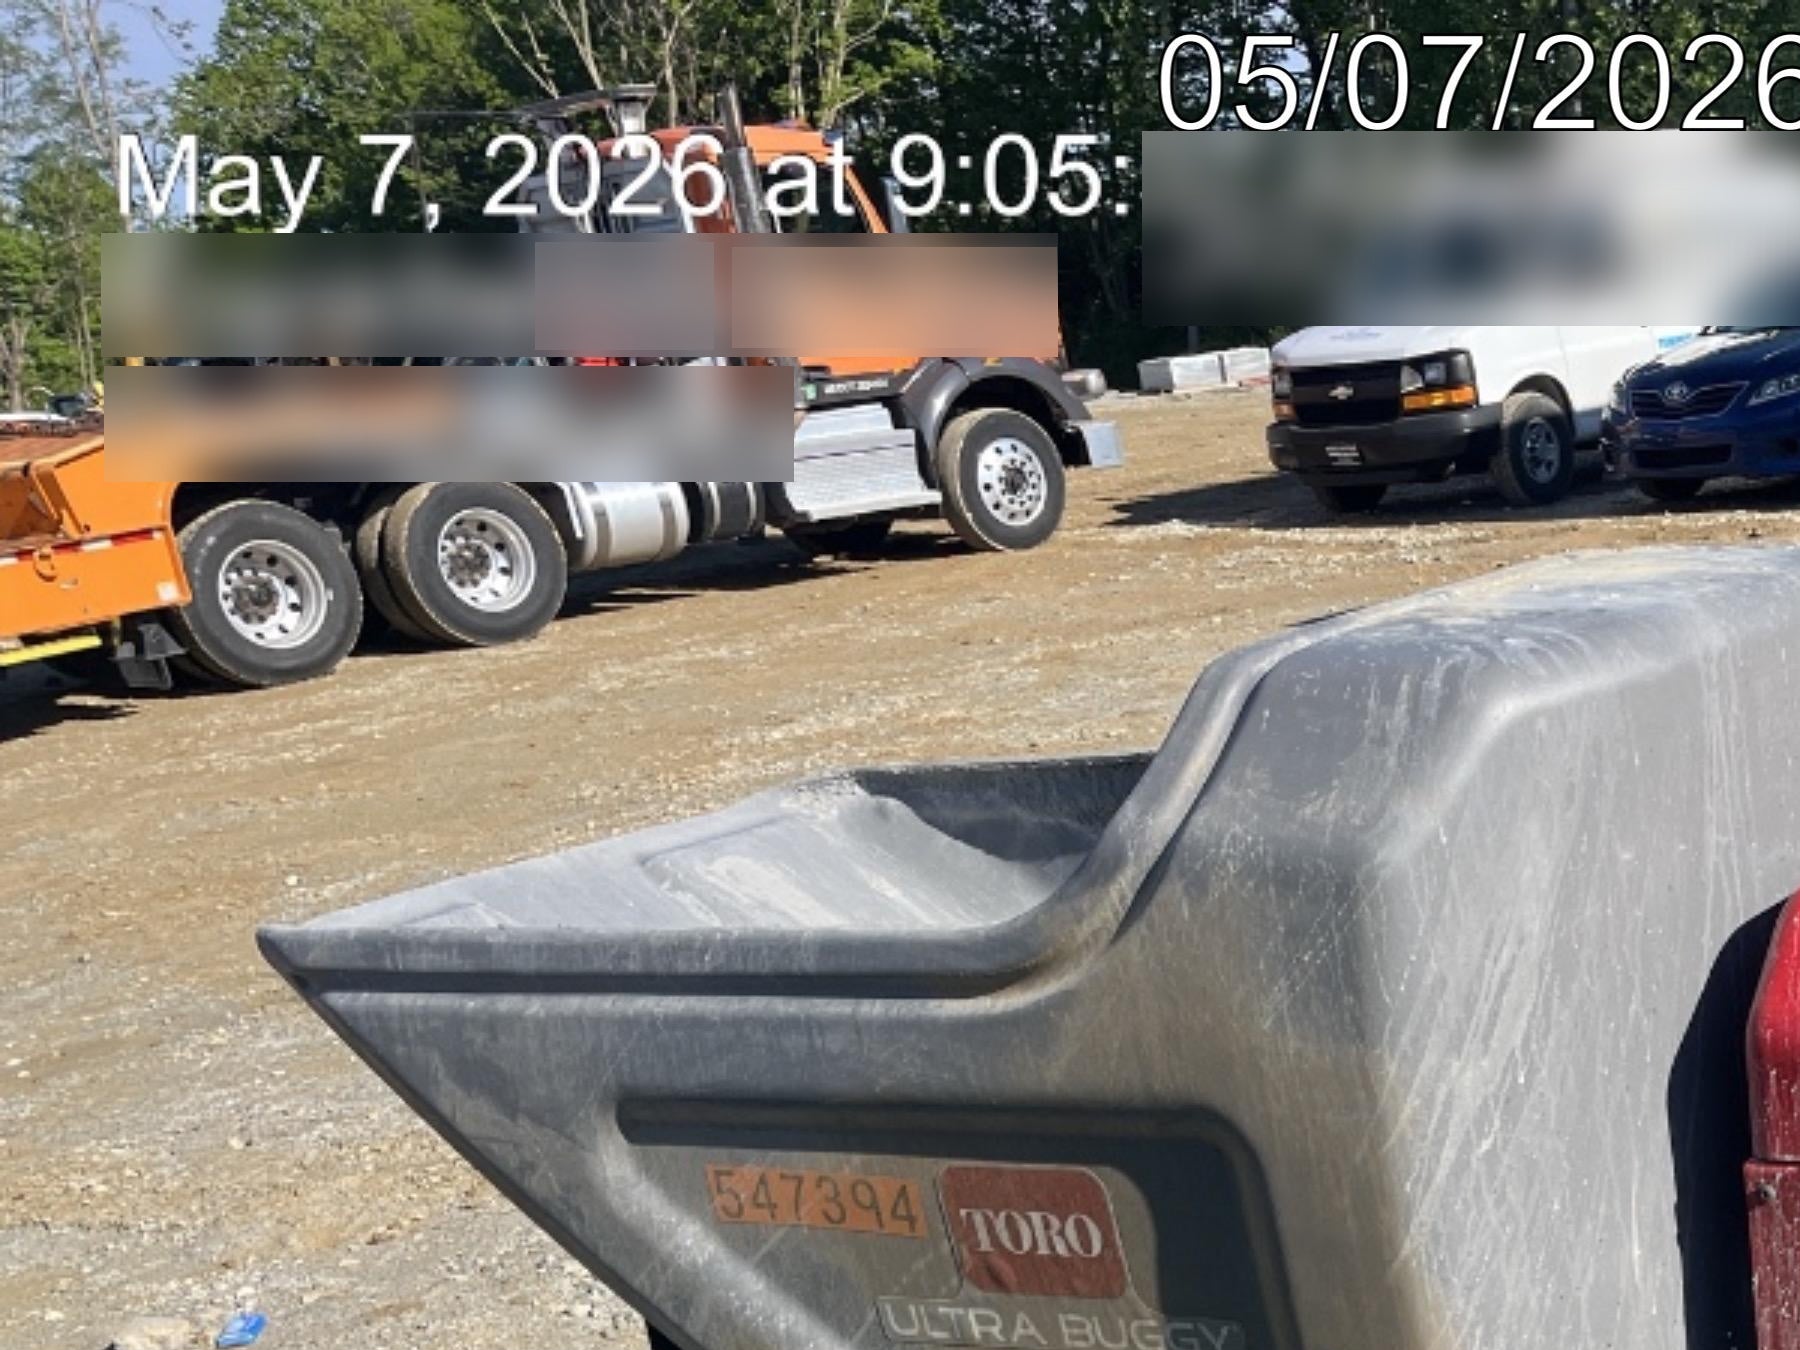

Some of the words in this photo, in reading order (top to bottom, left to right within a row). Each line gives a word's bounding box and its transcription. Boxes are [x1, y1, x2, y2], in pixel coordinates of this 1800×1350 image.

[713, 1168, 919, 1232] 547394
[959, 1207, 1103, 1258] TORO
[883, 1302, 1049, 1346] ULTRA
